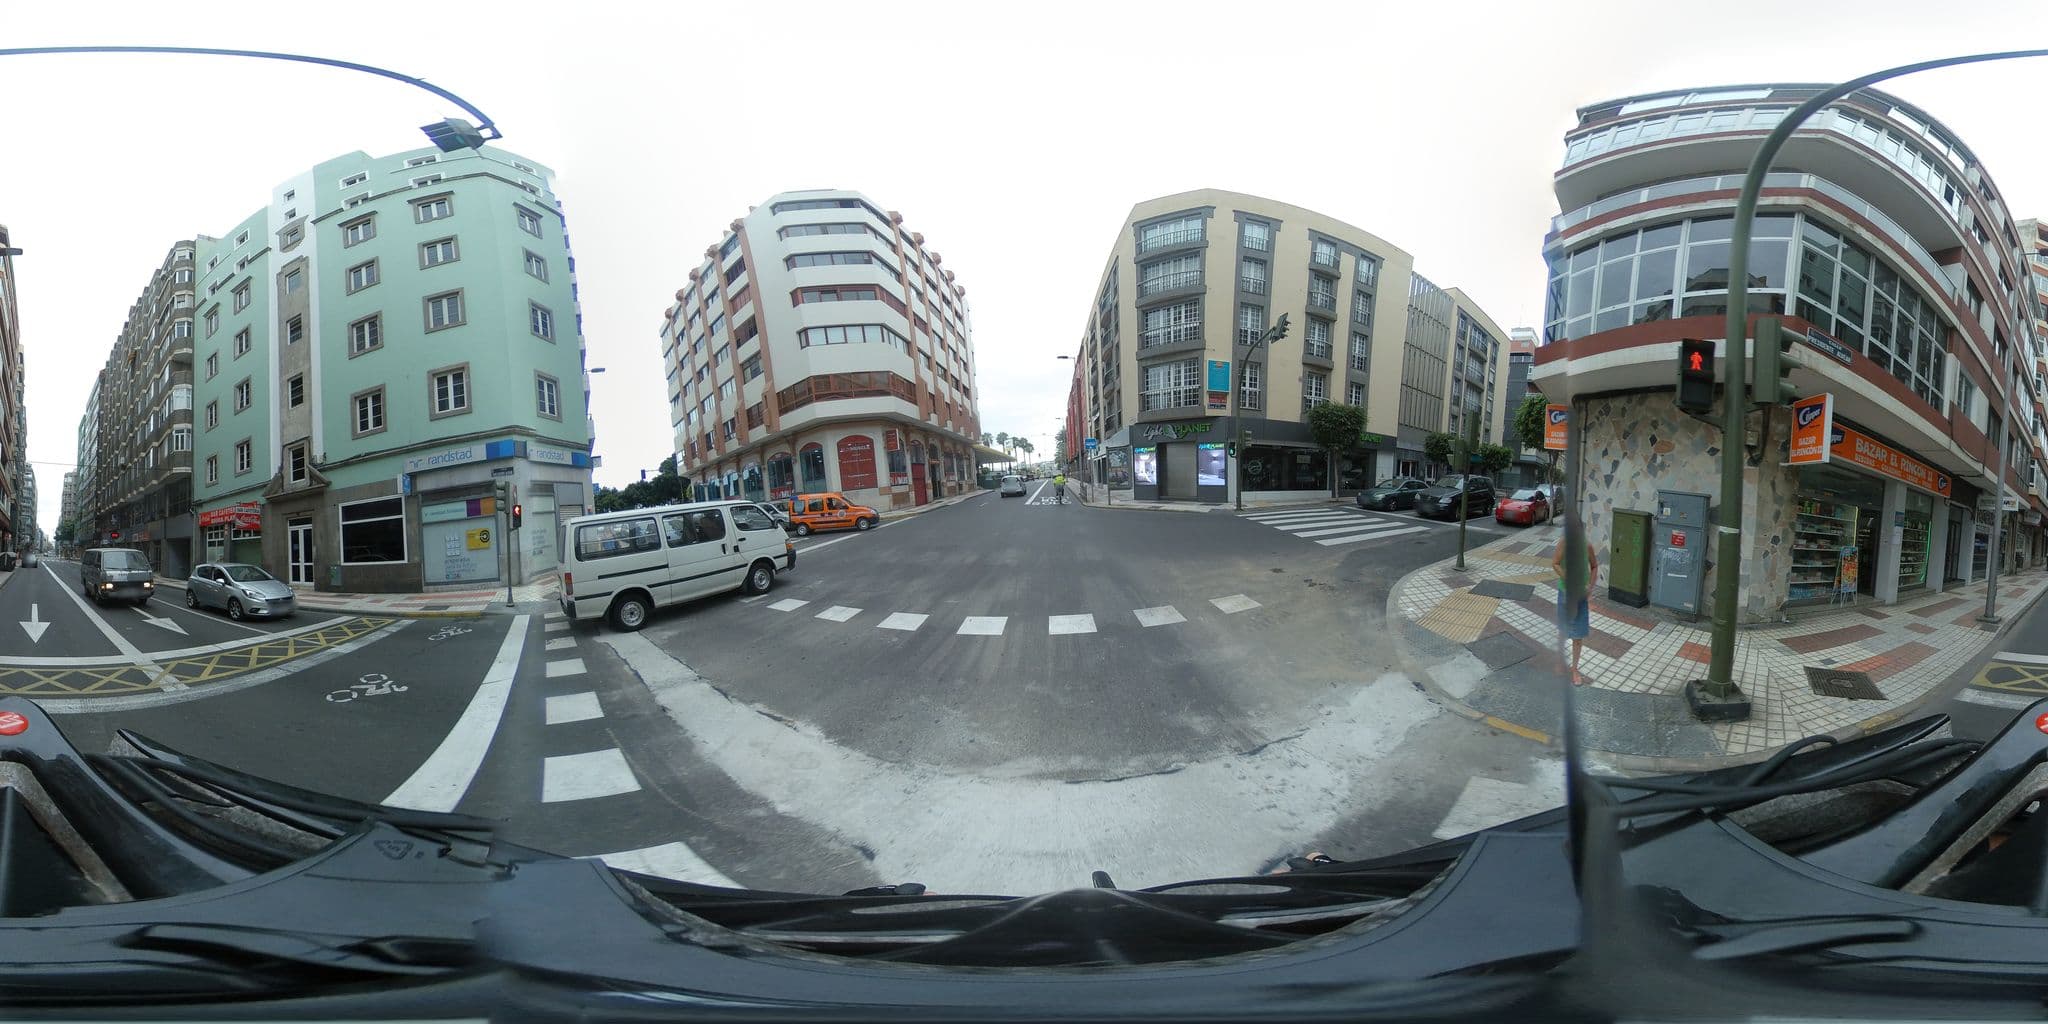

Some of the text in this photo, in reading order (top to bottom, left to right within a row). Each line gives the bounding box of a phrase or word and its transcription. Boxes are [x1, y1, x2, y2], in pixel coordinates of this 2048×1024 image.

[1175, 423, 1212, 440] PLANET
[1798, 436, 1817, 446] BAZAR
[427, 448, 473, 466] randstad
[536, 449, 564, 462] randstad
[1855, 437, 1888, 462] BAZAR
[1889, 452, 1898, 468] EL
